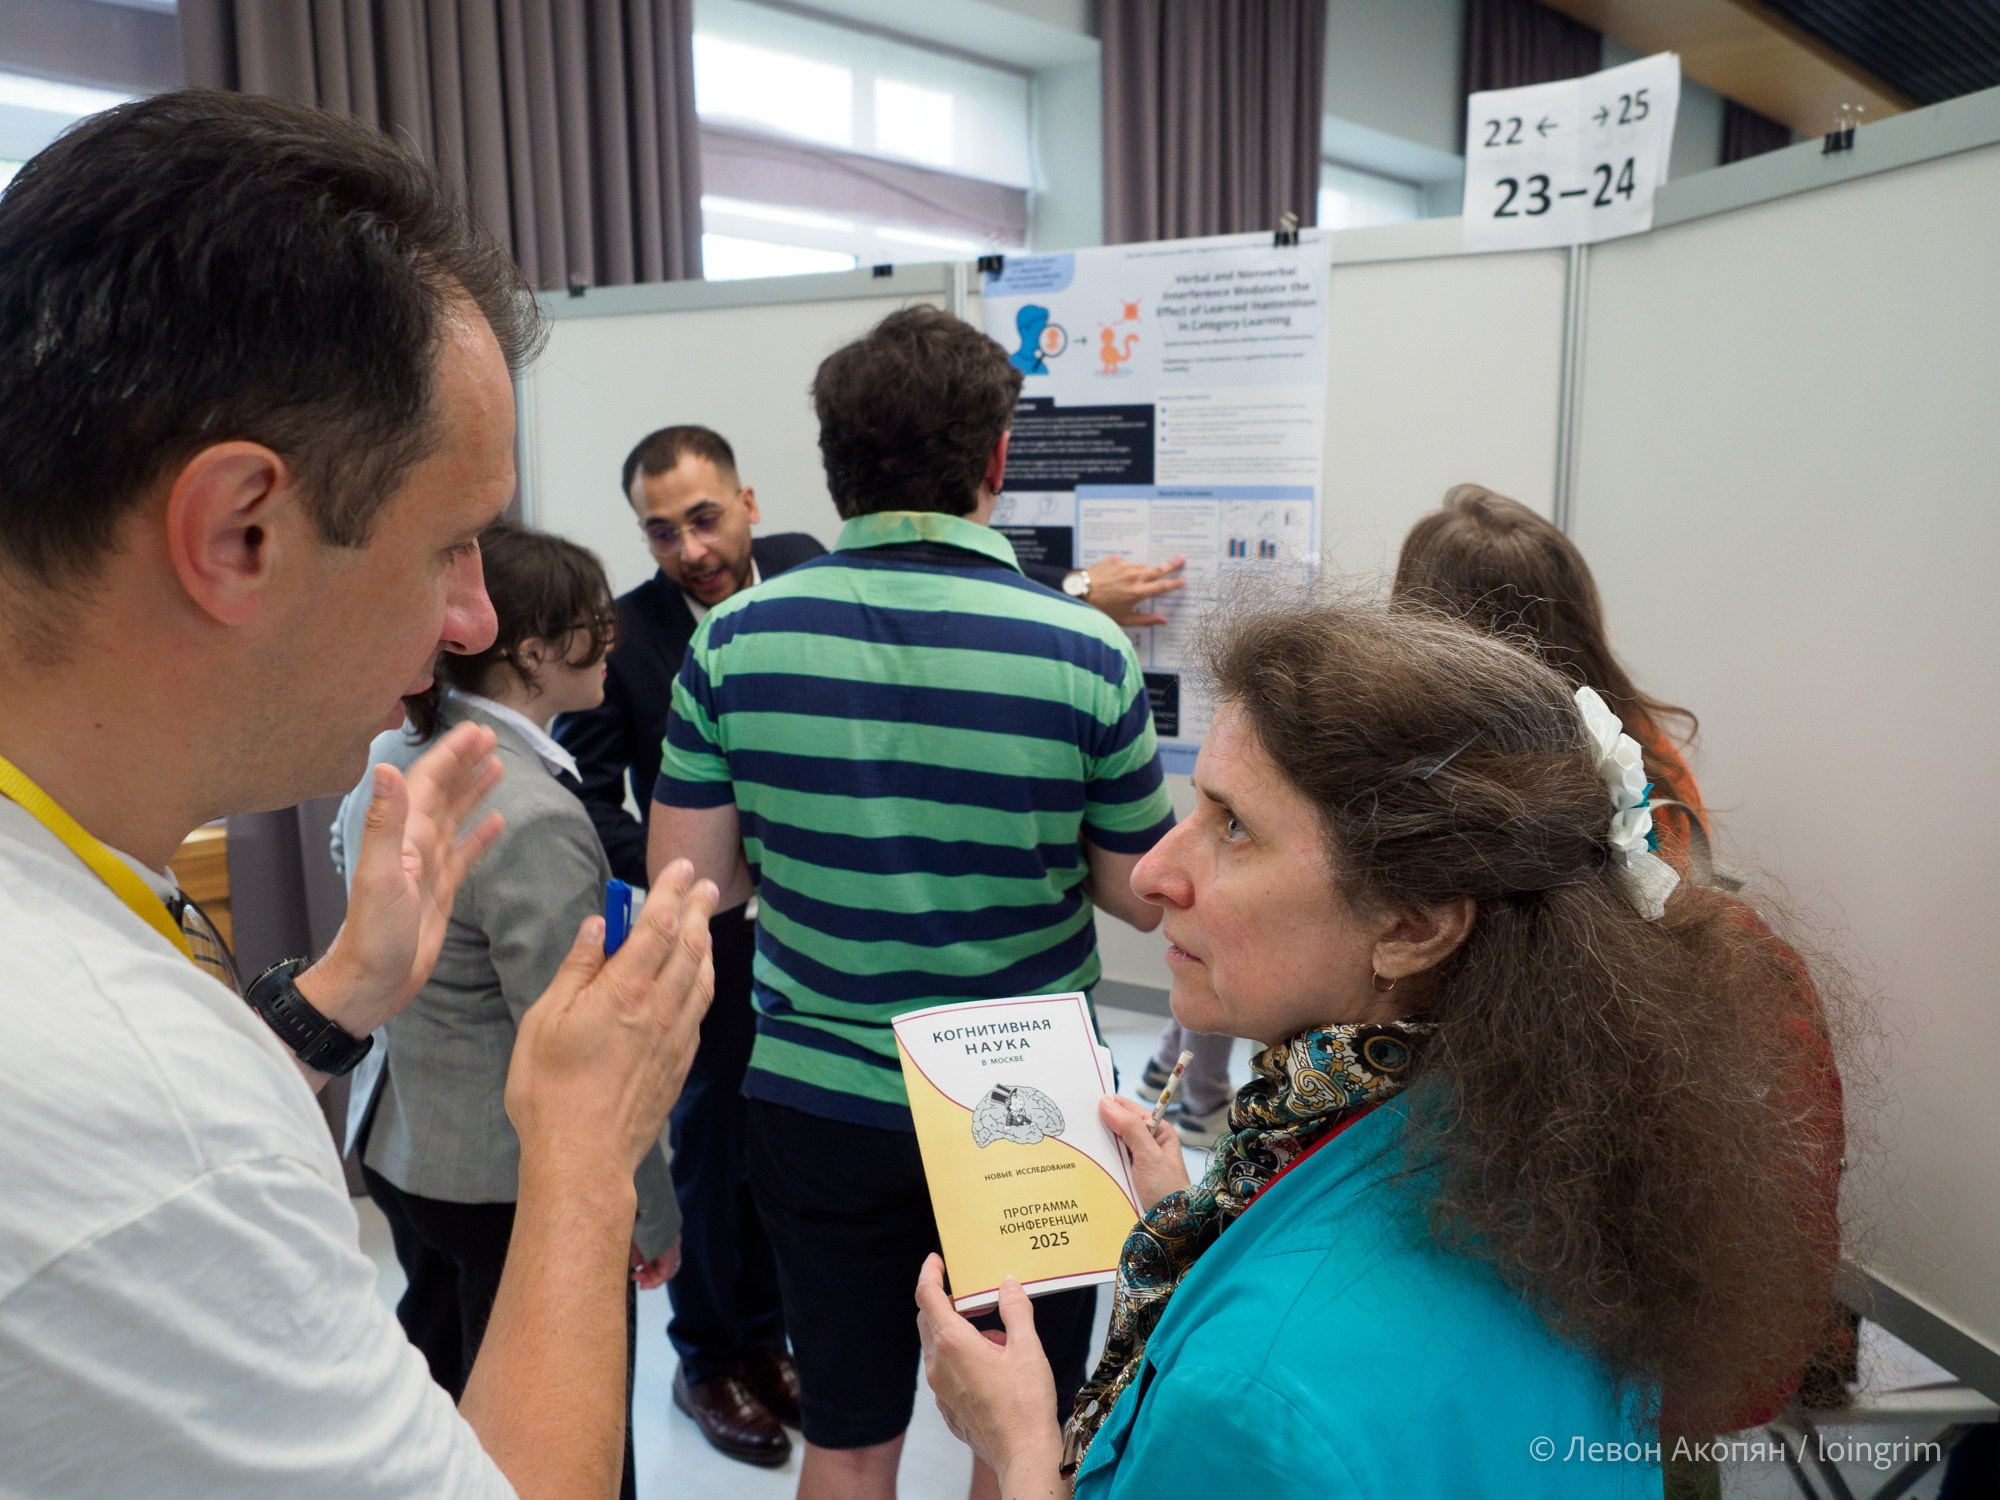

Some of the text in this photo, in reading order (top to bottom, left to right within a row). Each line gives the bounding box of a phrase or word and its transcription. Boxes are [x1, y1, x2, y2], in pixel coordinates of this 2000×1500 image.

[1484, 88, 1650, 148] 22 25
[1175, 267, 1297, 284] Verbal and Nonverbal
[1162, 287, 1230, 301] Interference
[1291, 281, 1309, 291] the
[1156, 304, 1187, 317] Effect
[1190, 303, 1202, 314] of
[1203, 301, 1248, 314] Learned
[1191, 317, 1240, 333] Category
[1242, 315, 1291, 329] Learning
[932, 1018, 1052, 1044] КОГНИТИВНАЯ
[965, 1037, 1031, 1056] НАУКА
[990, 1055, 1025, 1065] МОСКВЕ
[984, 1162, 1076, 1182] НОВЫЕ ИССЛЕДОВАНИЯ
[1003, 1199, 1079, 1219] ПРОГРАММА
[999, 1212, 1089, 1236] КОНФЕРЕНЦИИ
[1029, 1231, 1070, 1251] 2025
